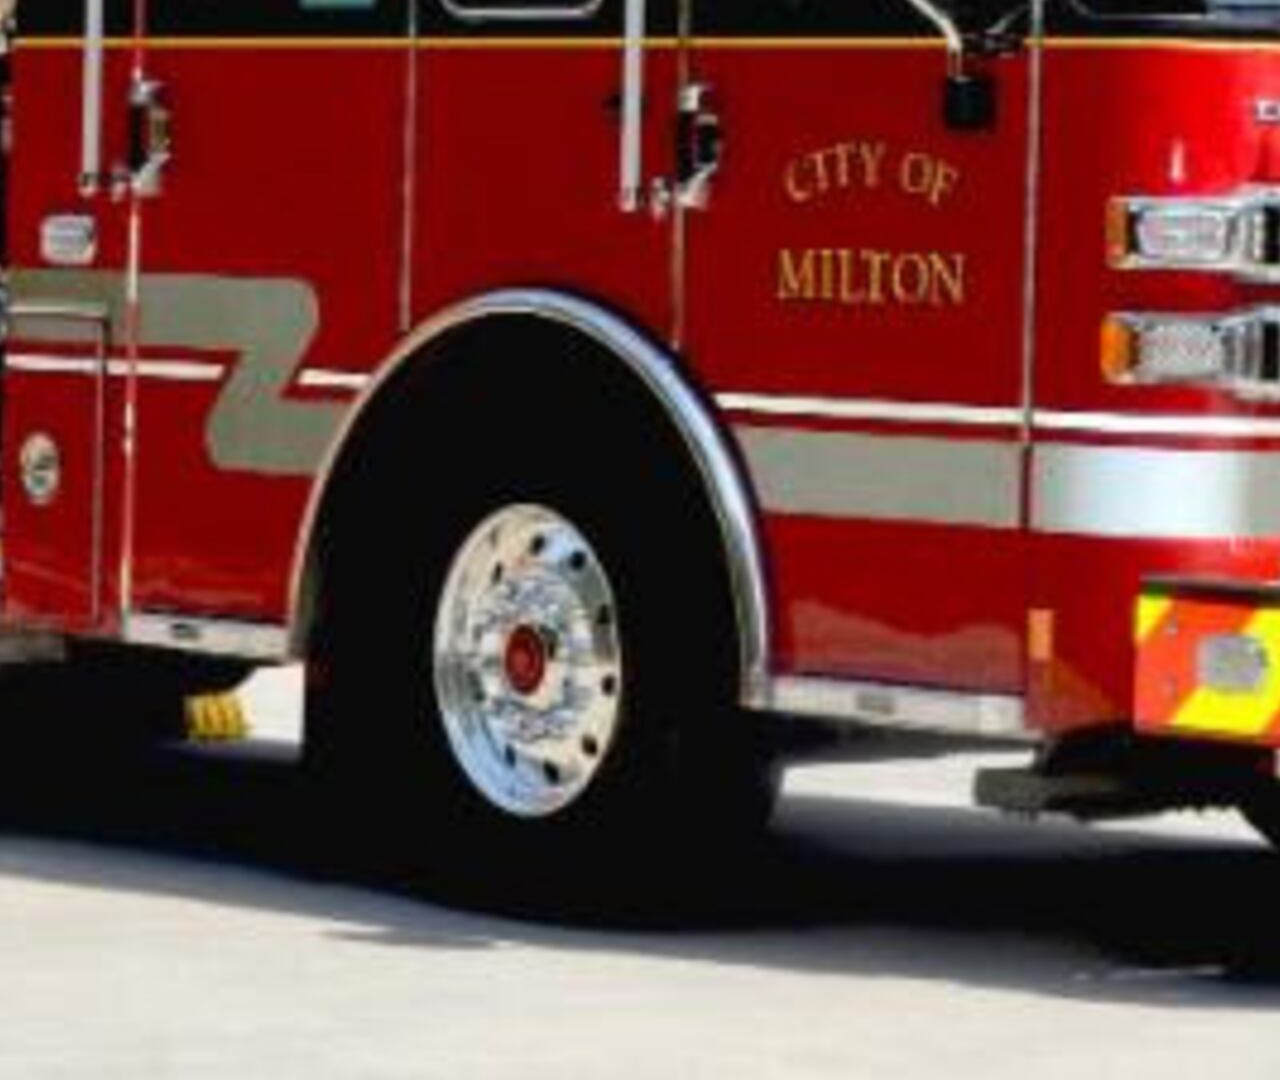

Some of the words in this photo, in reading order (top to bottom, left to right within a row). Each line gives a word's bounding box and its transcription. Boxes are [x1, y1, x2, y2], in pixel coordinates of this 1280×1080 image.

[785, 141, 887, 203] CITY
[900, 151, 960, 206] OF
[777, 248, 966, 305] MILTON
